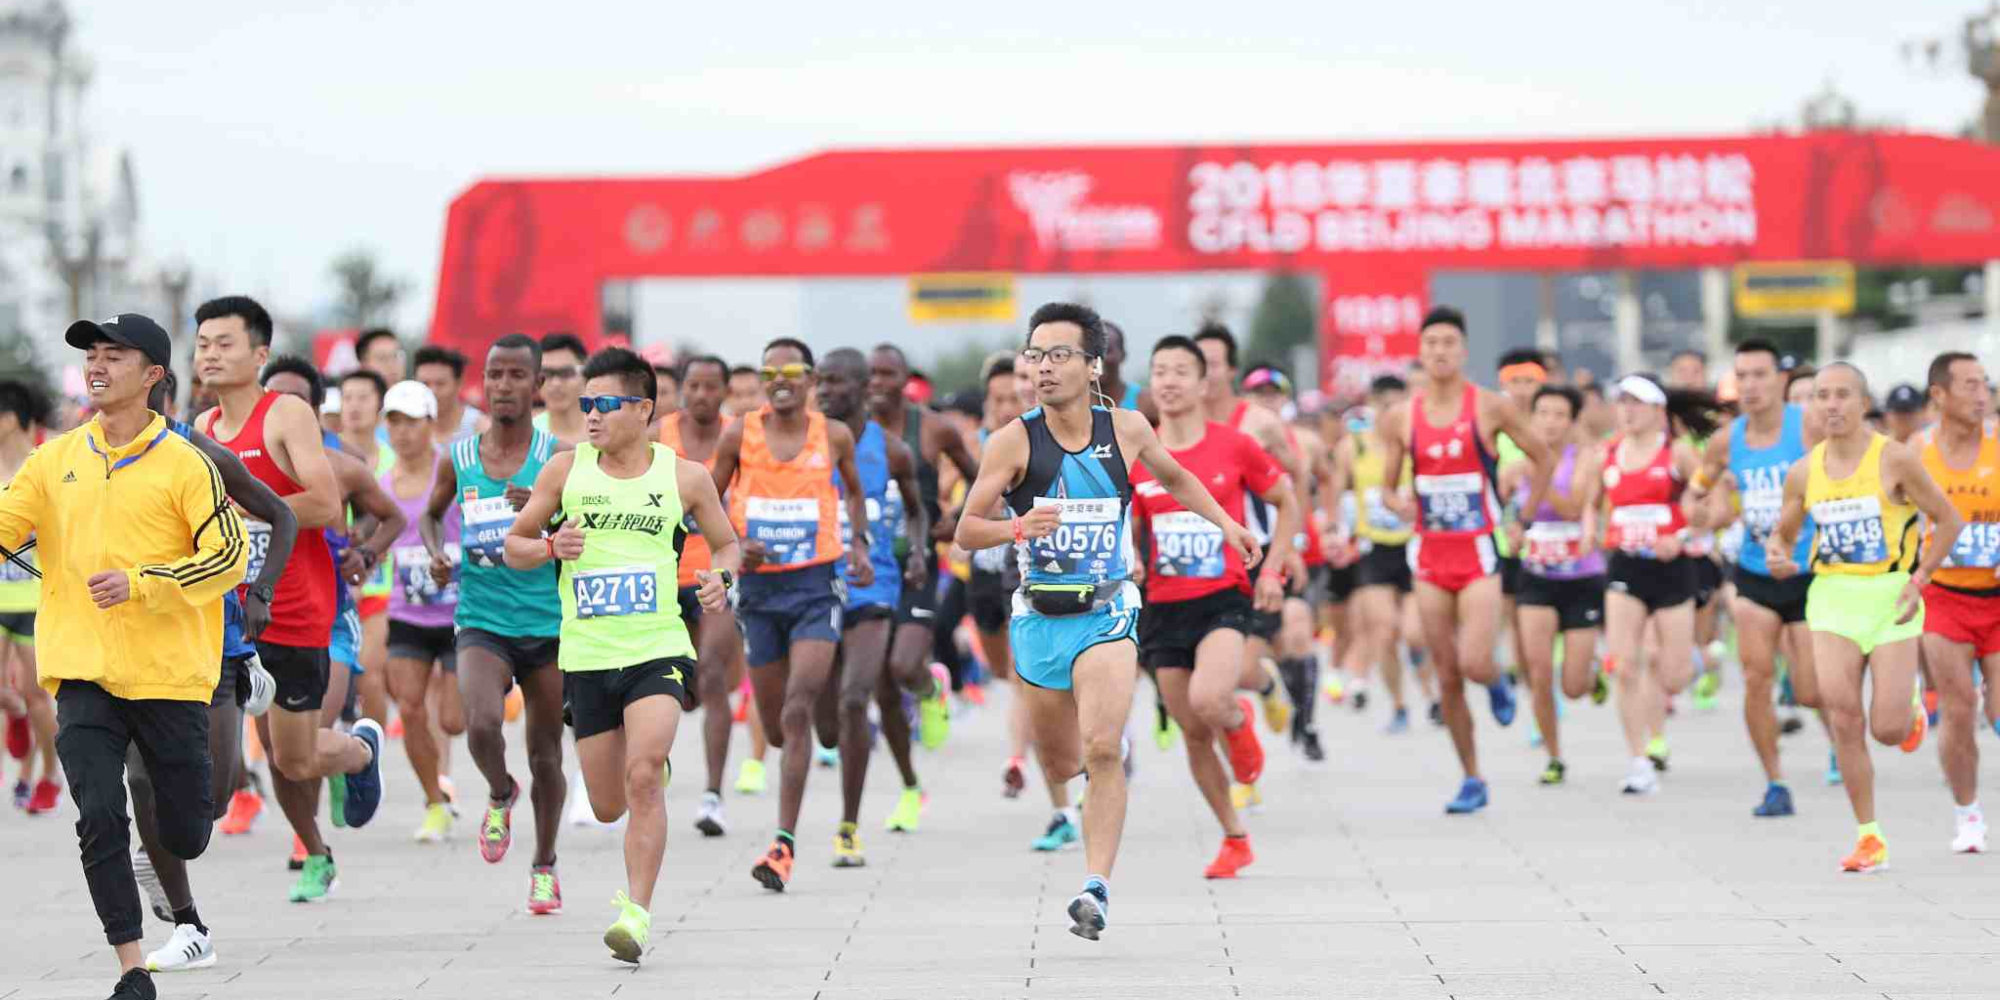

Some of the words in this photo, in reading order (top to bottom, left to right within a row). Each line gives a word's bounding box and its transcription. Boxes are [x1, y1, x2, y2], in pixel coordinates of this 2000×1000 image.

[1188, 210, 1311, 253] CFLD
[1316, 207, 1490, 252] BEIJING
[1499, 201, 1757, 248] MARATHON
[757, 525, 807, 540] SOLOMON
[577, 574, 655, 608] A2713
